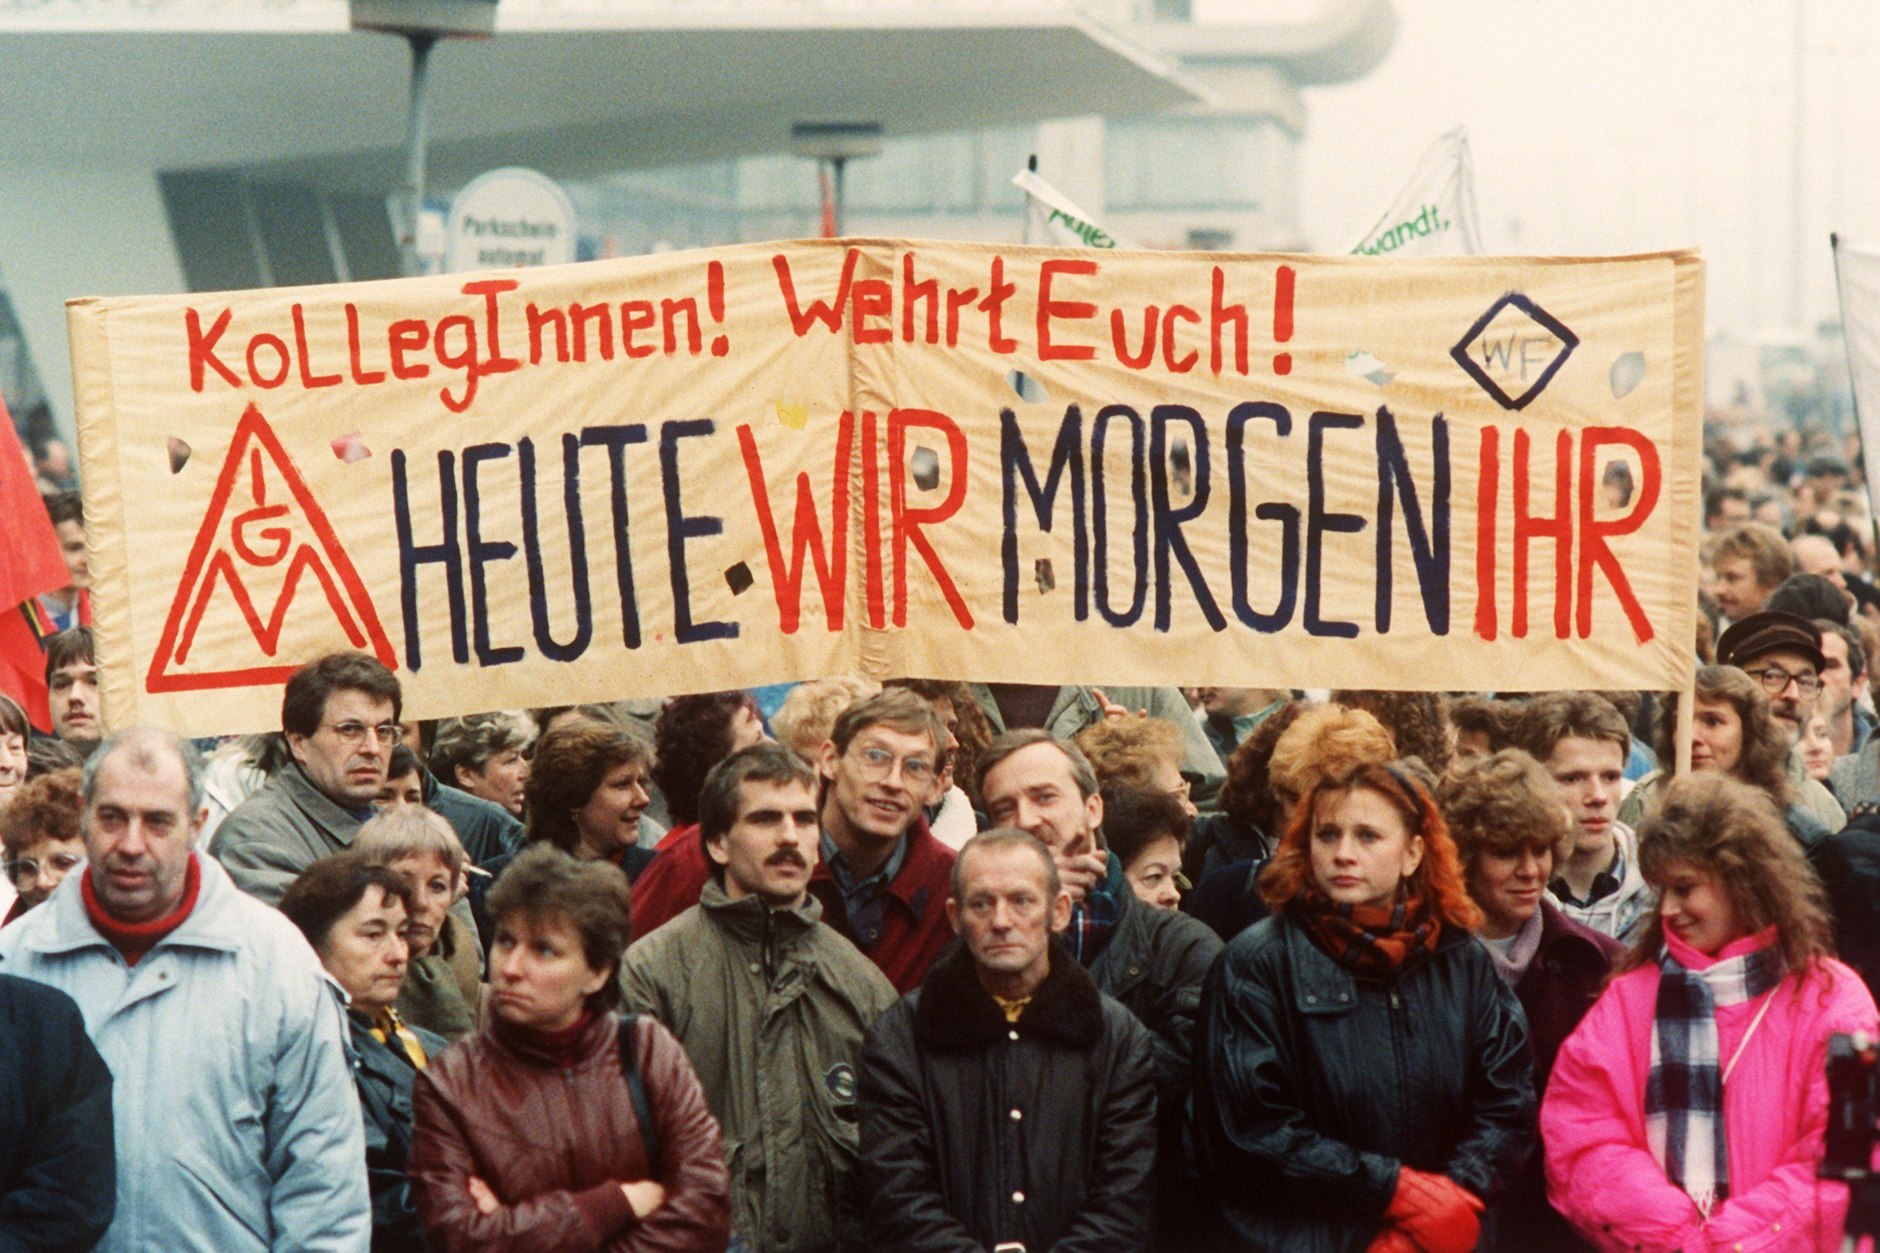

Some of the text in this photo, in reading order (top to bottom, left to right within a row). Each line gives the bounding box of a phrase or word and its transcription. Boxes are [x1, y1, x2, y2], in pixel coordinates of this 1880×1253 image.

[1350, 204, 1450, 256] wandt,
[1481, 330, 1551, 381] WF
[391, 401, 1663, 673] HEUTE WIR MORGEN IHR
